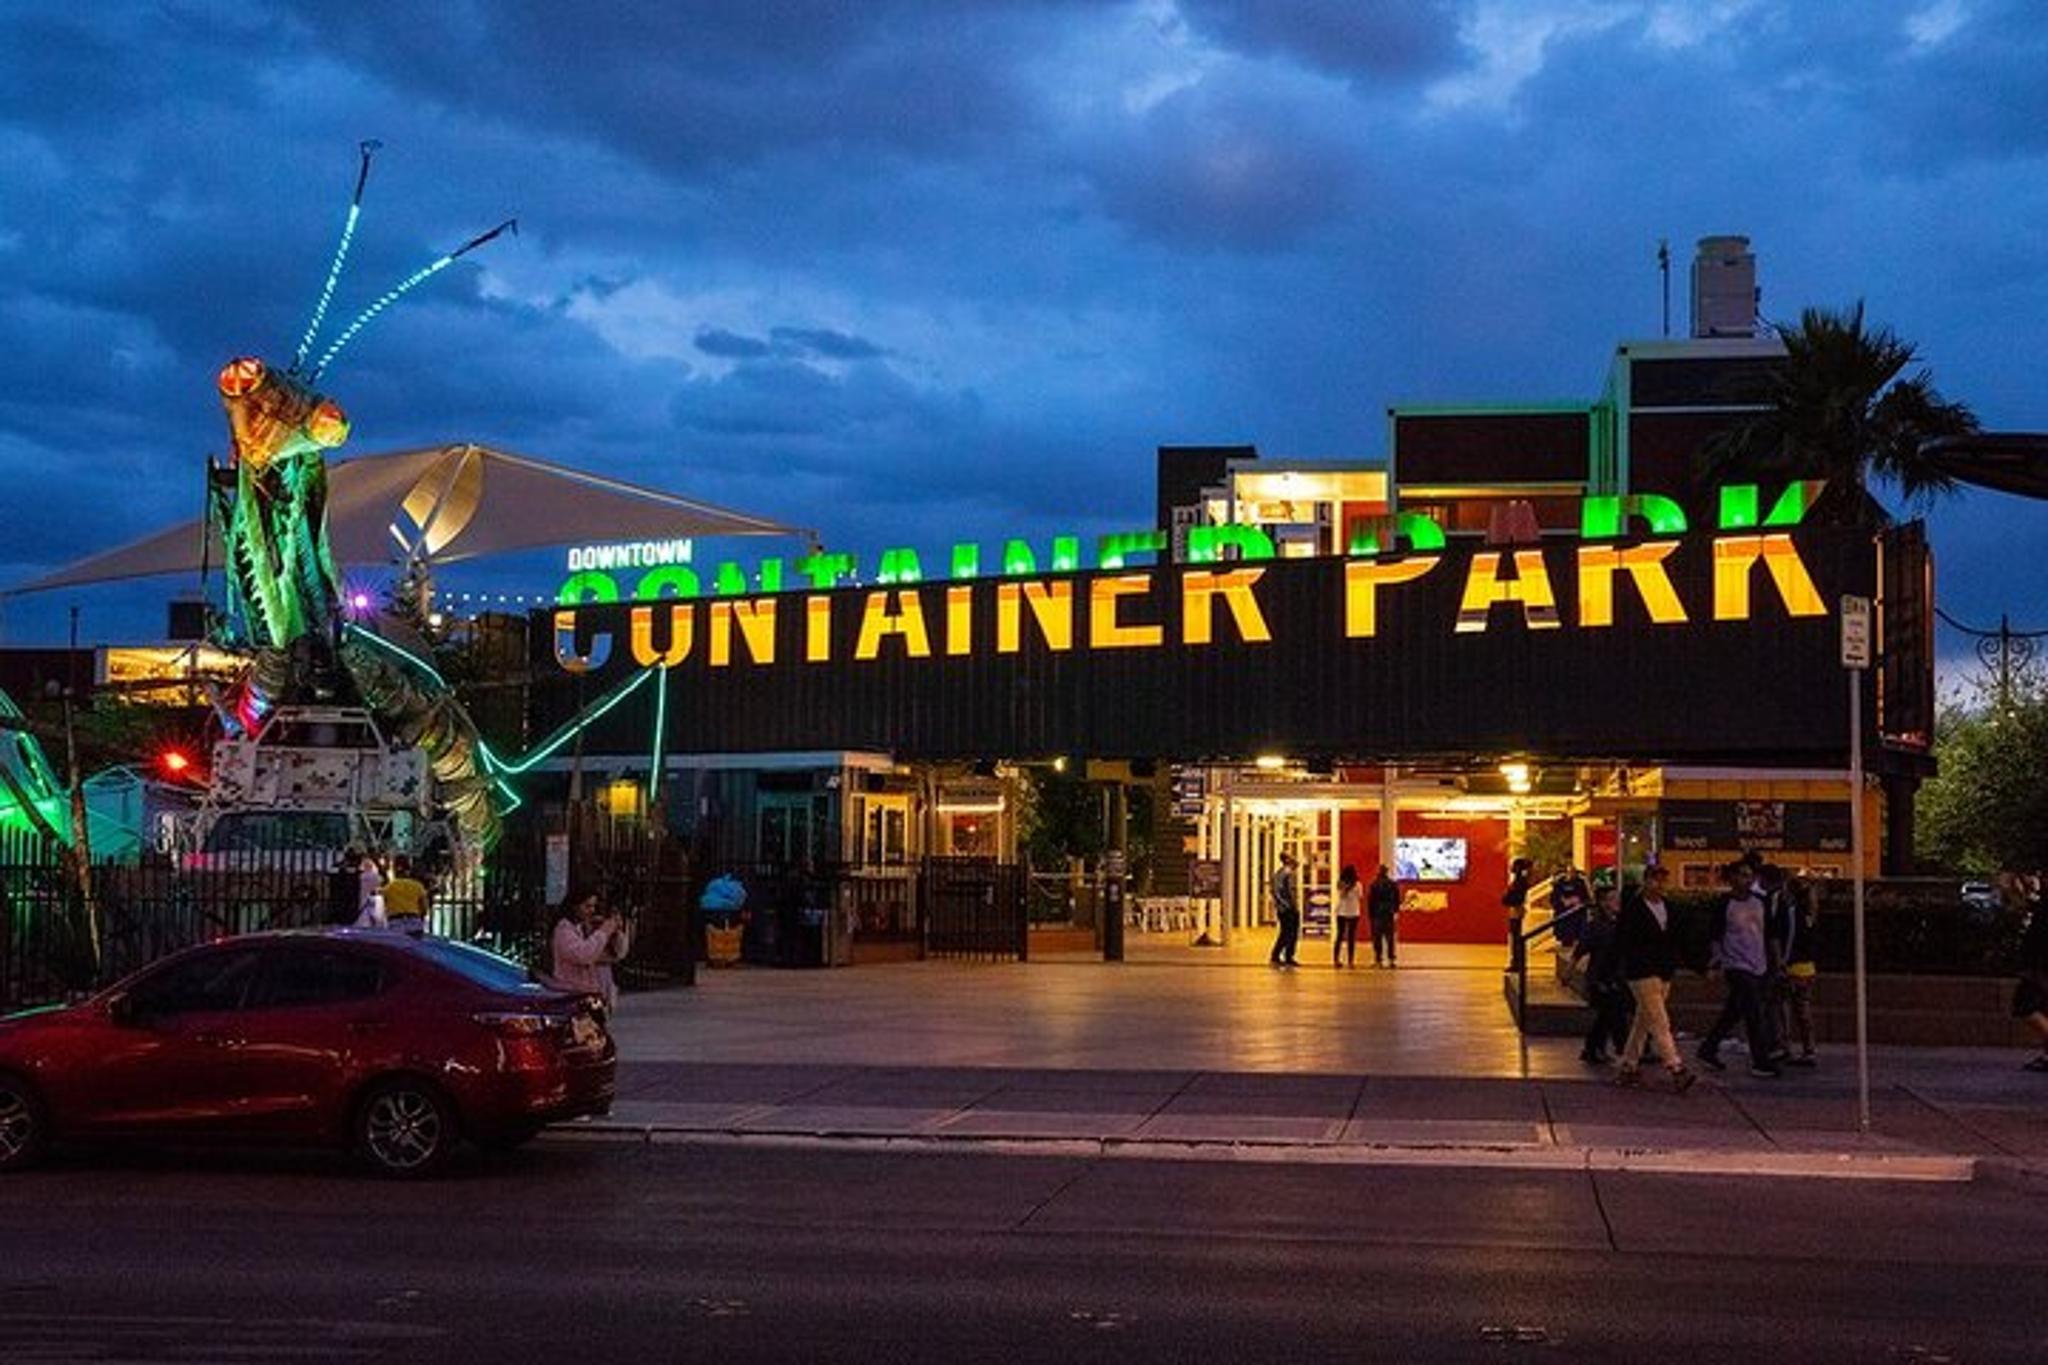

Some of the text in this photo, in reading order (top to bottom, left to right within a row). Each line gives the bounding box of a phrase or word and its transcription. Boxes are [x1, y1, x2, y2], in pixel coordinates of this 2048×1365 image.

[554, 480, 1829, 673] CONTAINER PARK
[568, 538, 692, 571] DOWNTOWN
